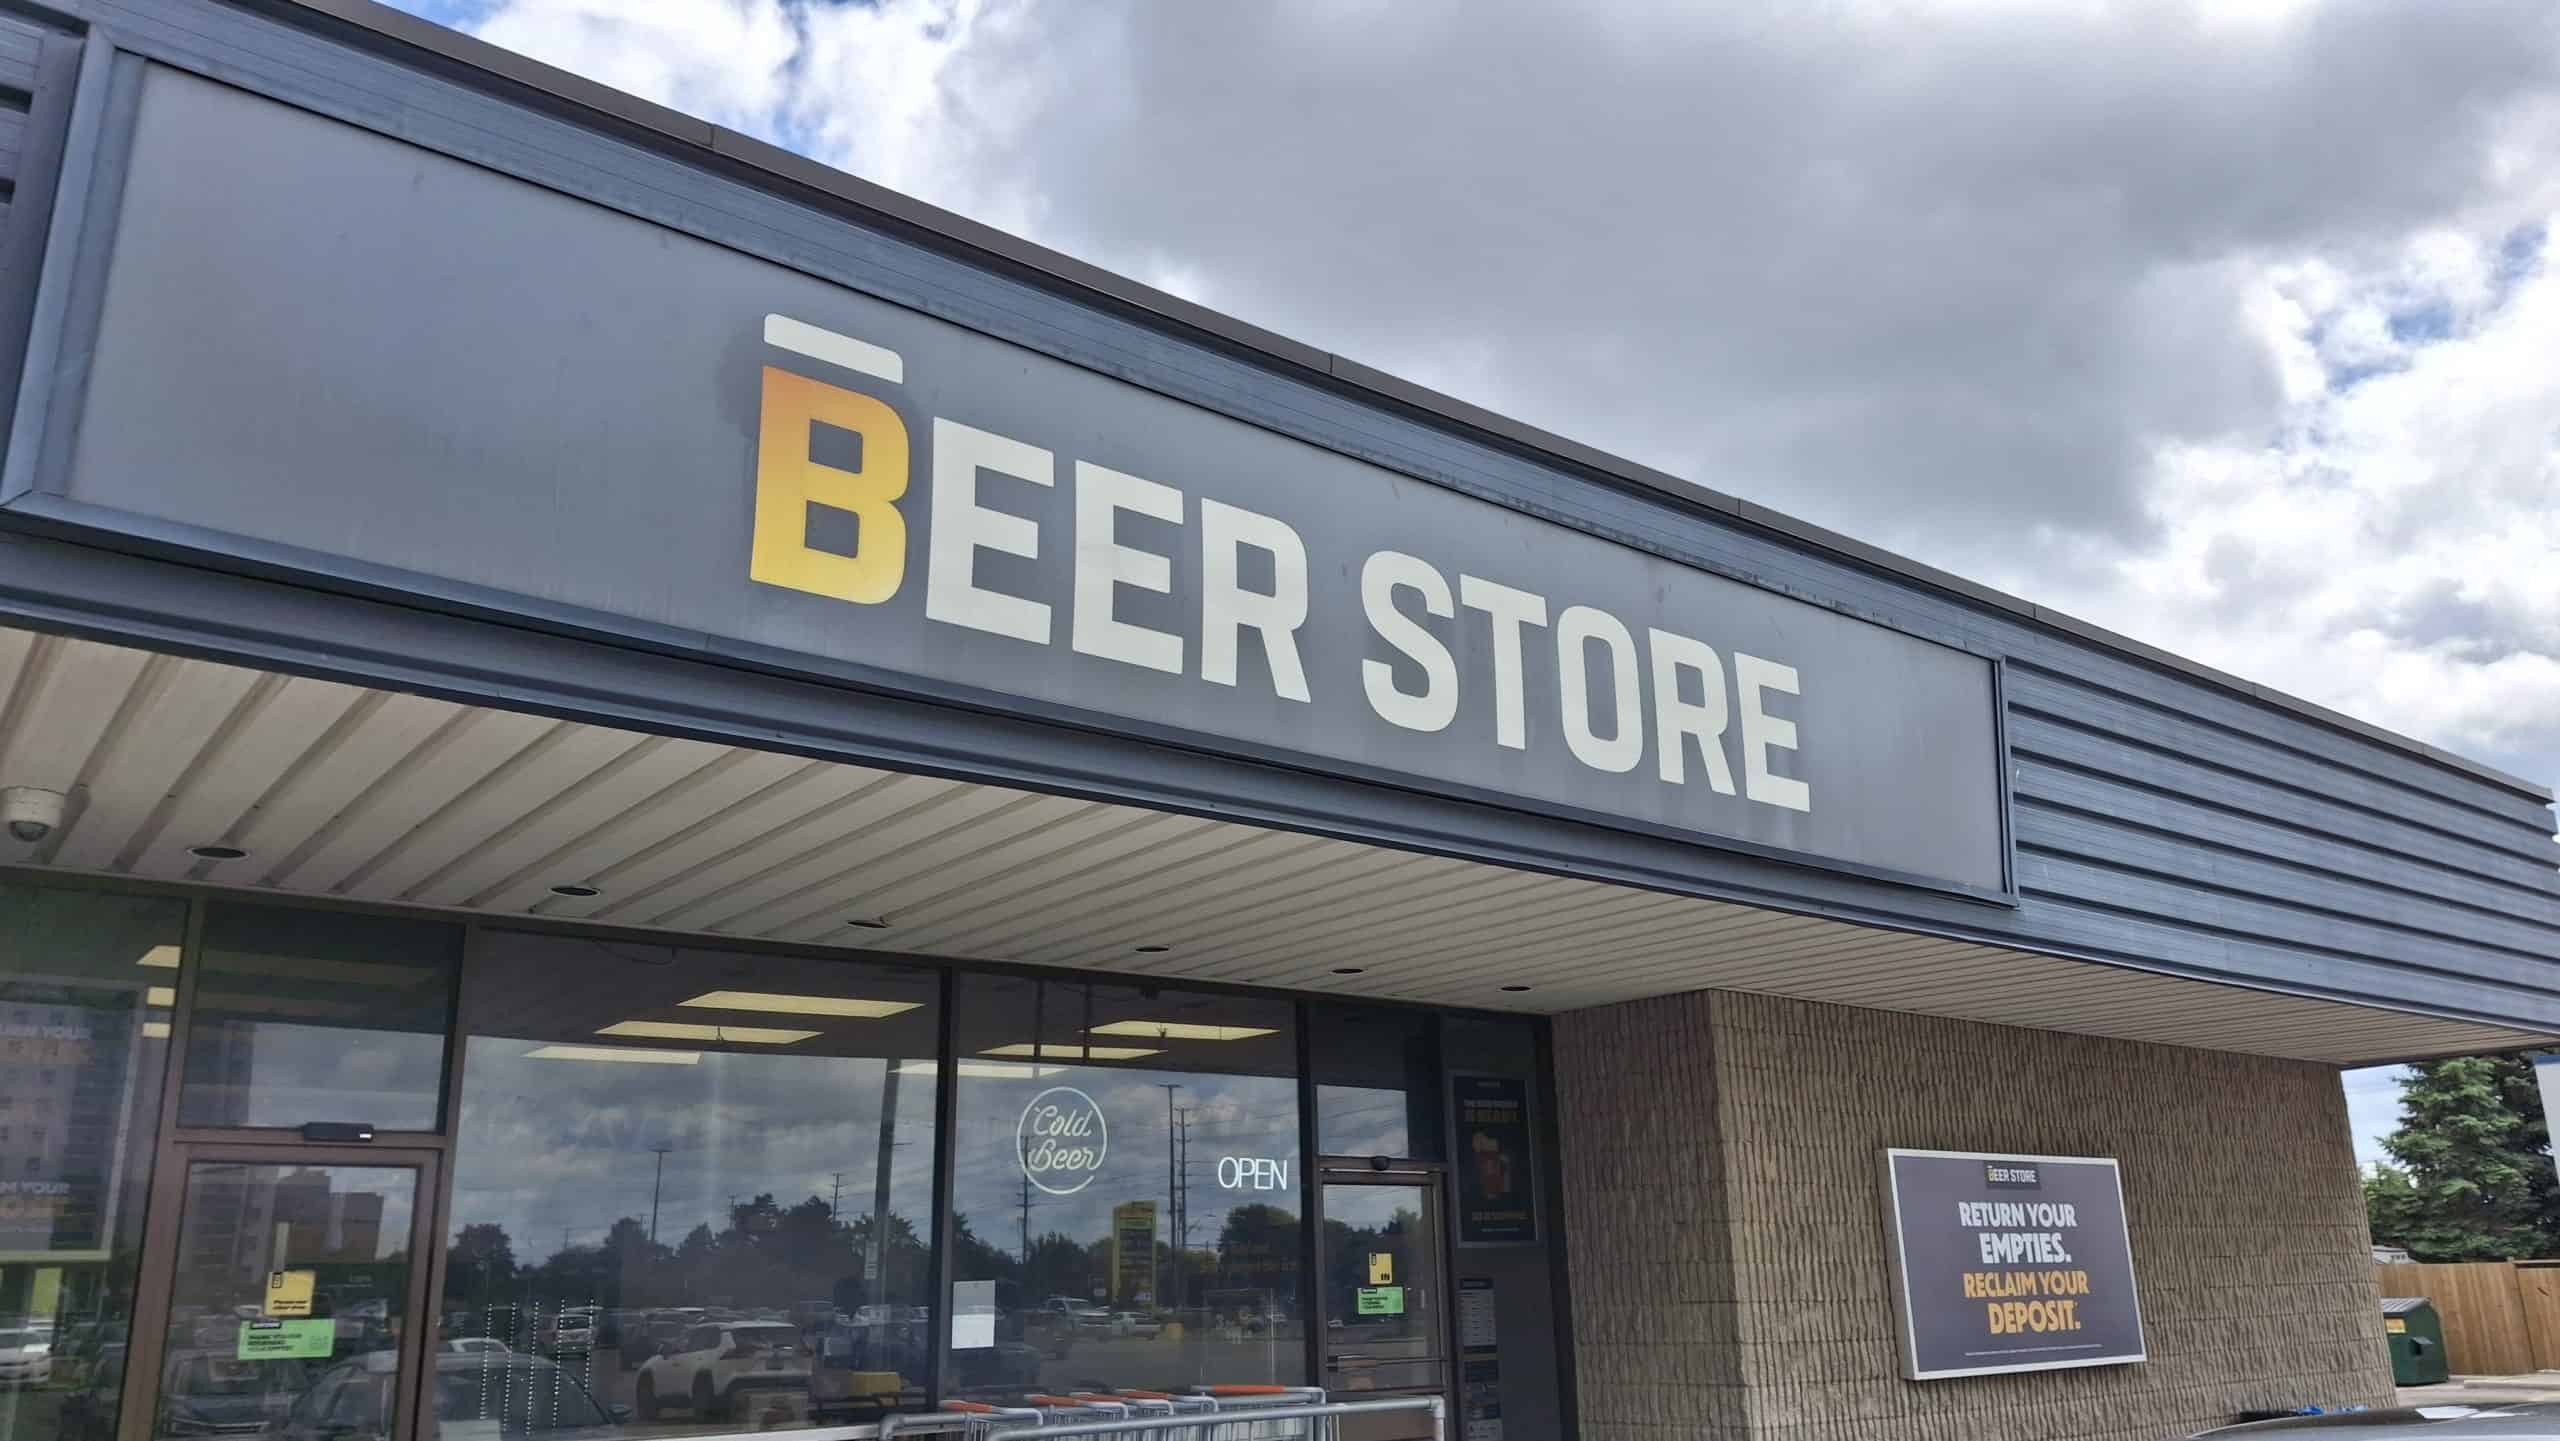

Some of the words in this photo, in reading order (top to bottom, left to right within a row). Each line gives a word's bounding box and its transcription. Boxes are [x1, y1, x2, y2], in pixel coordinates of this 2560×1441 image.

[750, 313, 1311, 703] BEER
[1361, 551, 1810, 812] STORE
[1033, 1105, 1093, 1137] Cold
[1028, 1139, 1097, 1172] Beer
[1218, 1156, 1287, 1190] OPEN
[1987, 1165, 2009, 1182] BEER
[2010, 1169, 2037, 1183] STORE
[1959, 1202, 2026, 1226] RETURN
[2027, 1203, 2077, 1227] YOUR
[1979, 1233, 2072, 1264] EMPTIES.
[1963, 1271, 2038, 1298] RECLAIM
[2039, 1270, 2090, 1295] YOUR
